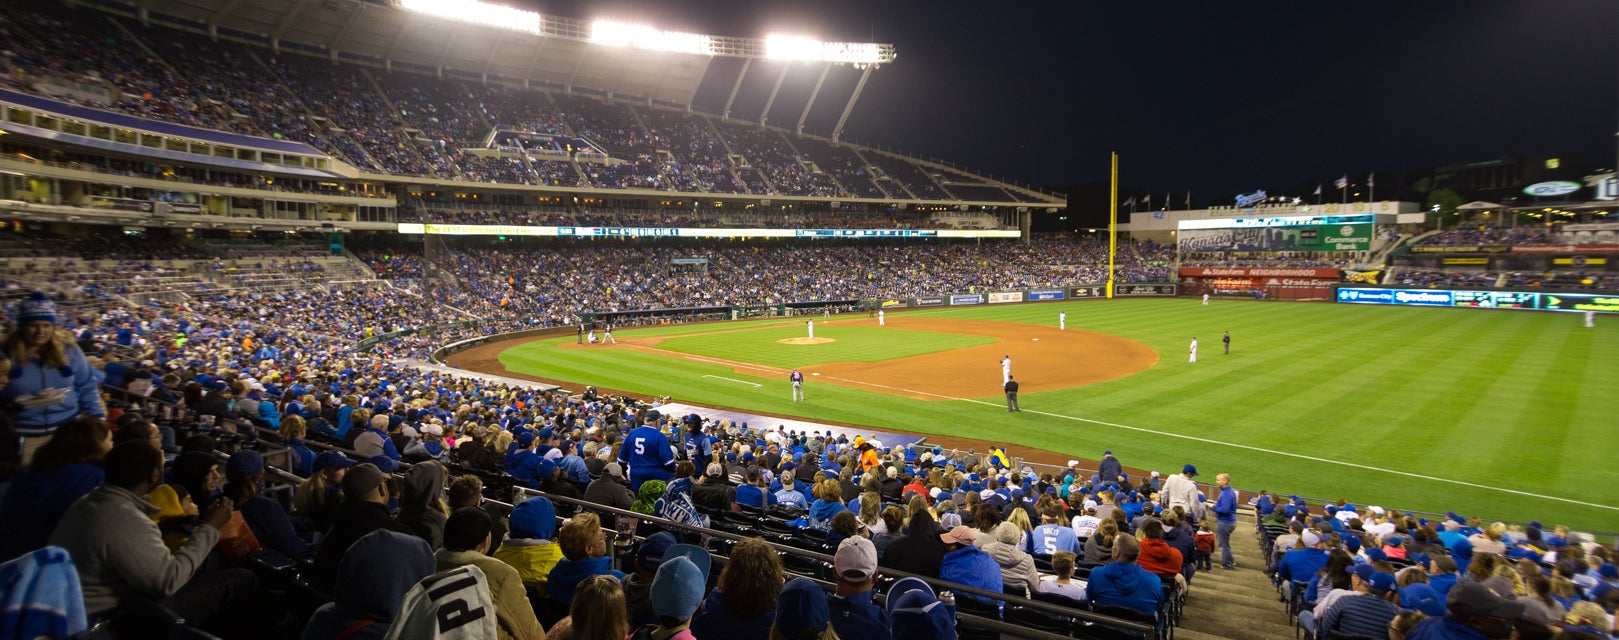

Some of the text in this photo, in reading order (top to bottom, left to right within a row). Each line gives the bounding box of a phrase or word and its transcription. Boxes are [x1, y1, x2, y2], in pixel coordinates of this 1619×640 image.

[1153, 210, 1165, 219] 42
[1180, 227, 1262, 252] Kansas City
[1324, 236, 1369, 244] Commerce
[1249, 269, 1316, 277] NEIGHBORHOOD
[634, 437, 646, 455] 5
[1043, 527, 1060, 535] BRETT
[1044, 536, 1057, 555] 5
